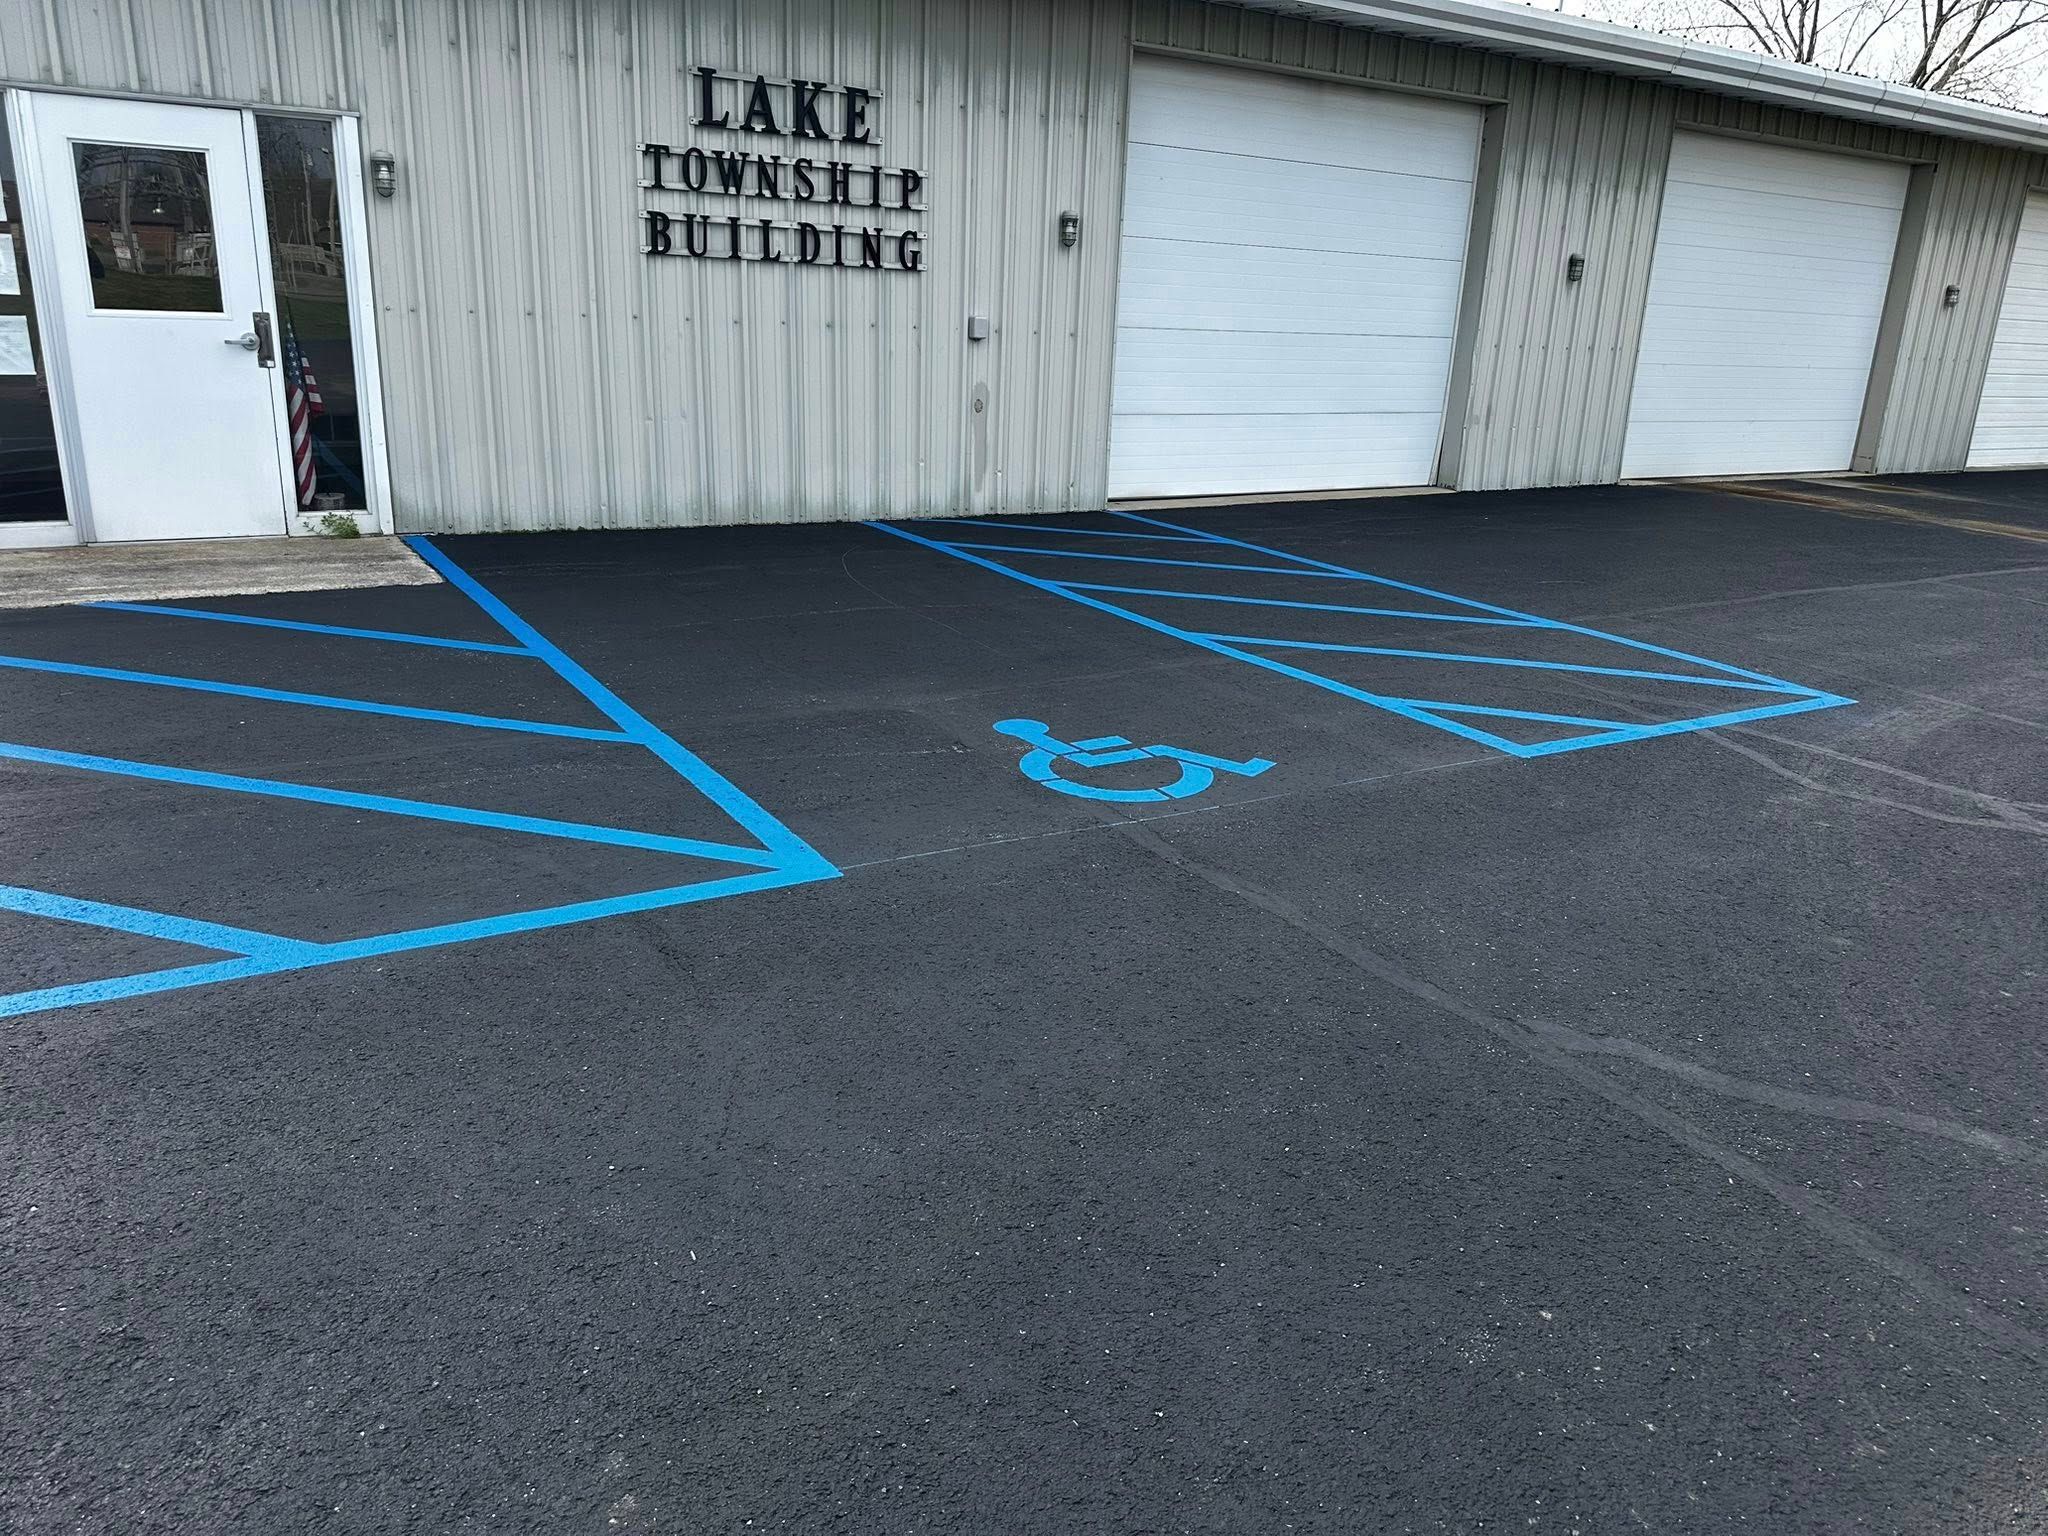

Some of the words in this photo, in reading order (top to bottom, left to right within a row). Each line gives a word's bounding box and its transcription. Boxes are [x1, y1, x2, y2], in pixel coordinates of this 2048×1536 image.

[698, 66, 870, 144] LAKE
[645, 144, 921, 209] TOWNSHIP
[647, 210, 921, 271] BUILDING
